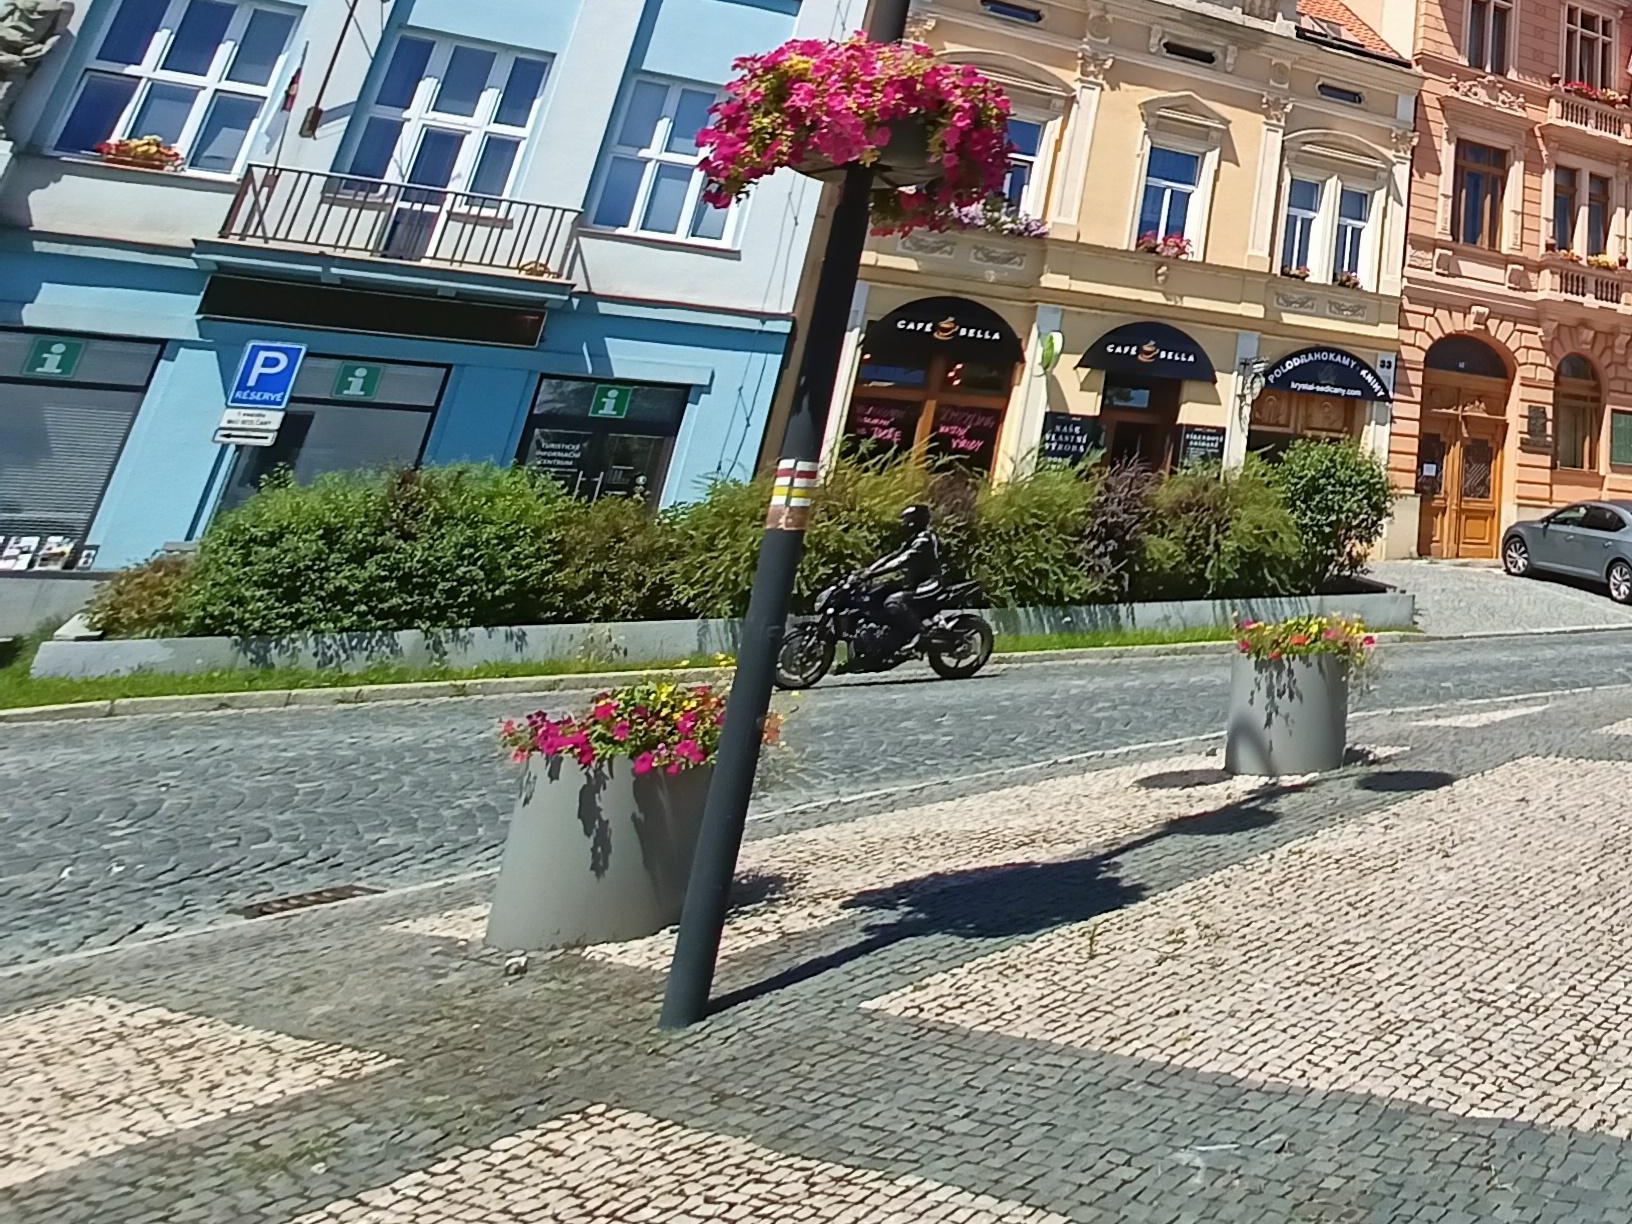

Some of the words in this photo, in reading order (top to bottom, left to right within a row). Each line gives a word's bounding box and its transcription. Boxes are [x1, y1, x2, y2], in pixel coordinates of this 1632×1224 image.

[896, 319, 934, 333] CAFÉ
[959, 327, 1001, 341] BELLA
[1106, 343, 1138, 356] CAFÉ
[1159, 351, 1195, 363] BELLA
[246, 350, 289, 387] P
[1379, 359, 1392, 370] 33
